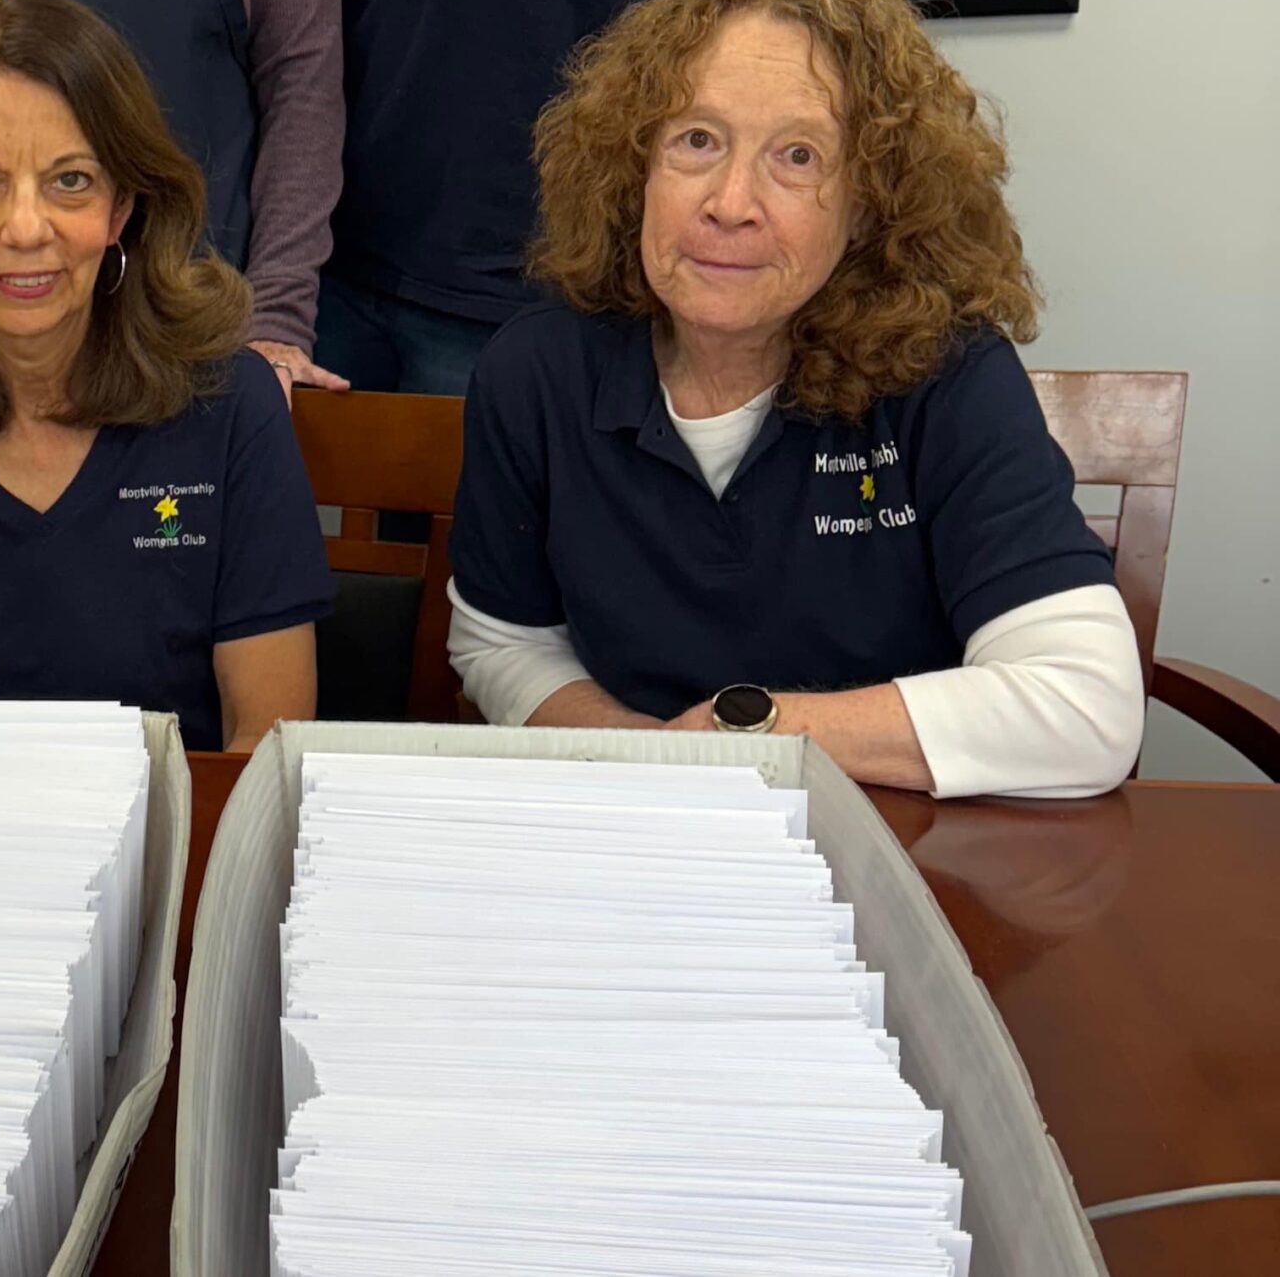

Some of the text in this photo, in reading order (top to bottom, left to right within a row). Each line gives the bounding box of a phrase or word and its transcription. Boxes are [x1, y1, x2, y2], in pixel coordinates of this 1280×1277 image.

[118, 482, 216, 500] Montville Township
[878, 504, 917, 529] Club
[132, 533, 207, 549] Womens Club
